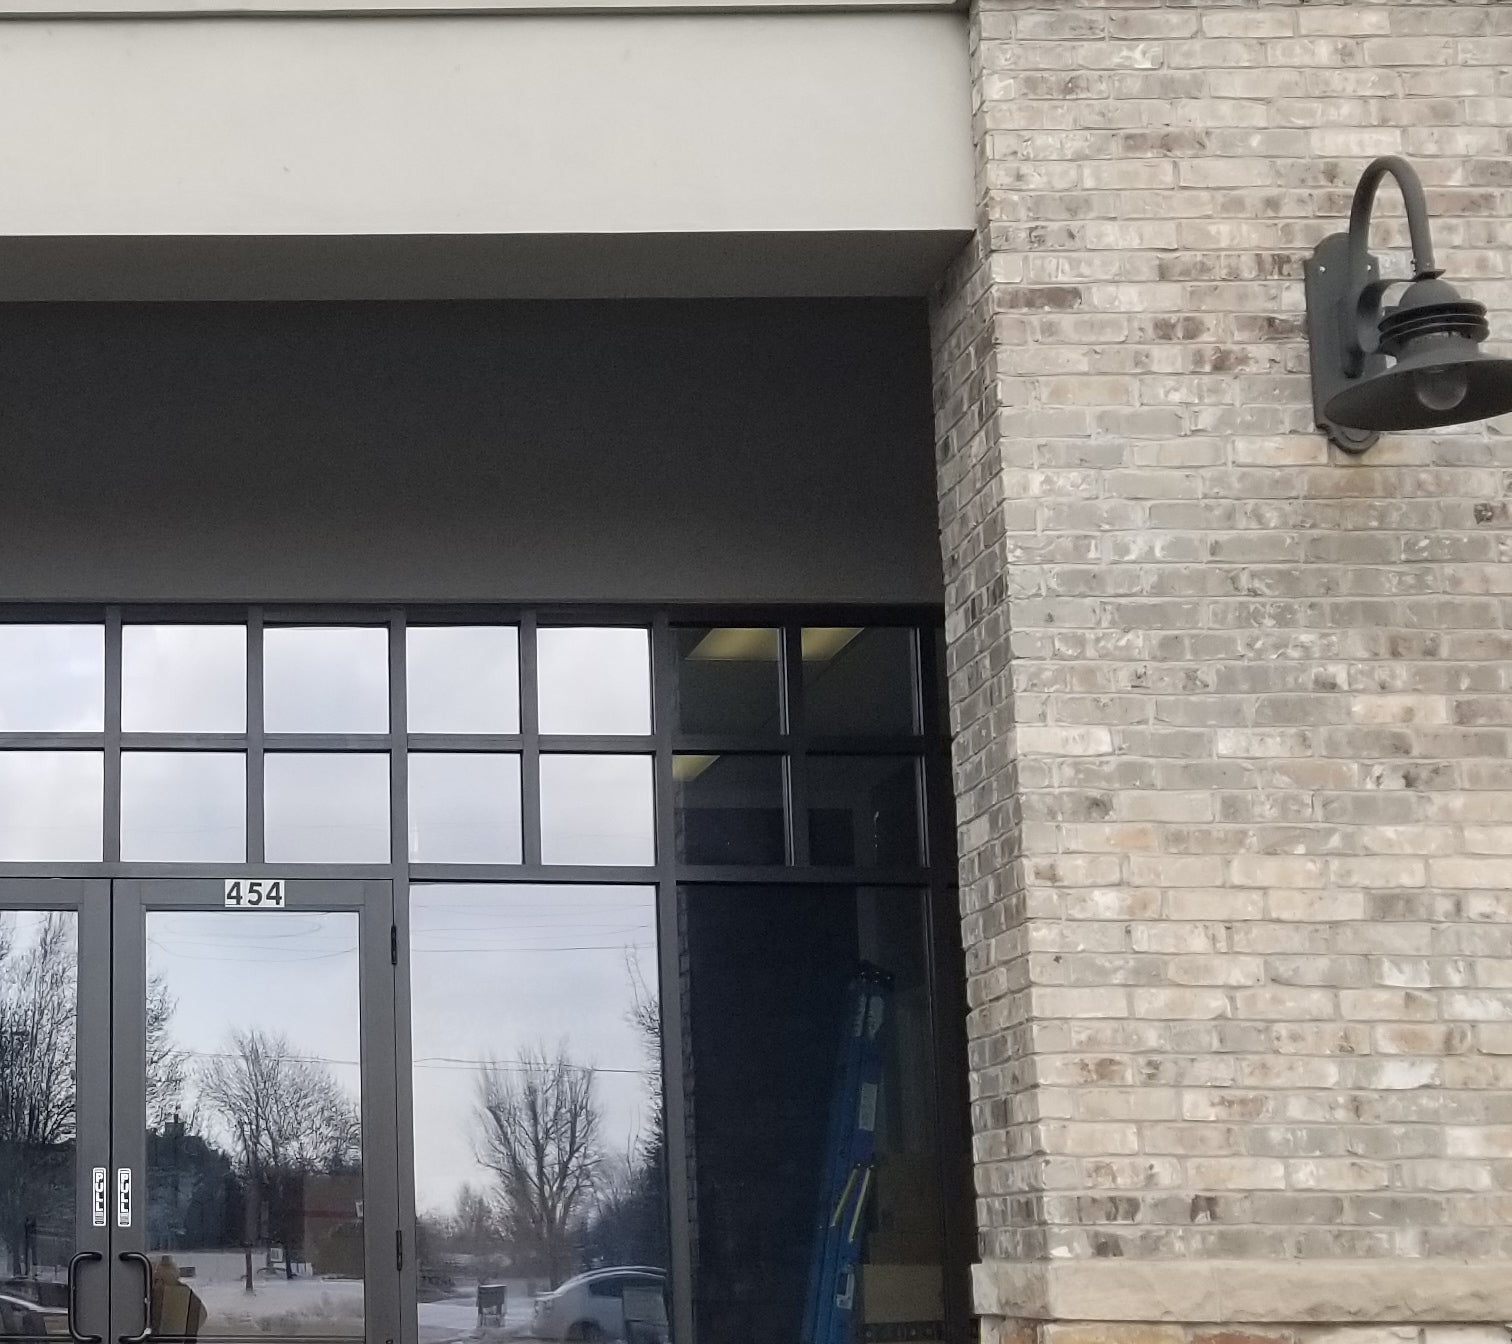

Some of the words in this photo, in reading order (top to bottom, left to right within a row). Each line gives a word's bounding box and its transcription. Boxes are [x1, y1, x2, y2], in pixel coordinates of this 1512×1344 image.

[226, 881, 283, 906] 454
[94, 1172, 104, 1212] PULL
[120, 1173, 129, 1213] PULL
